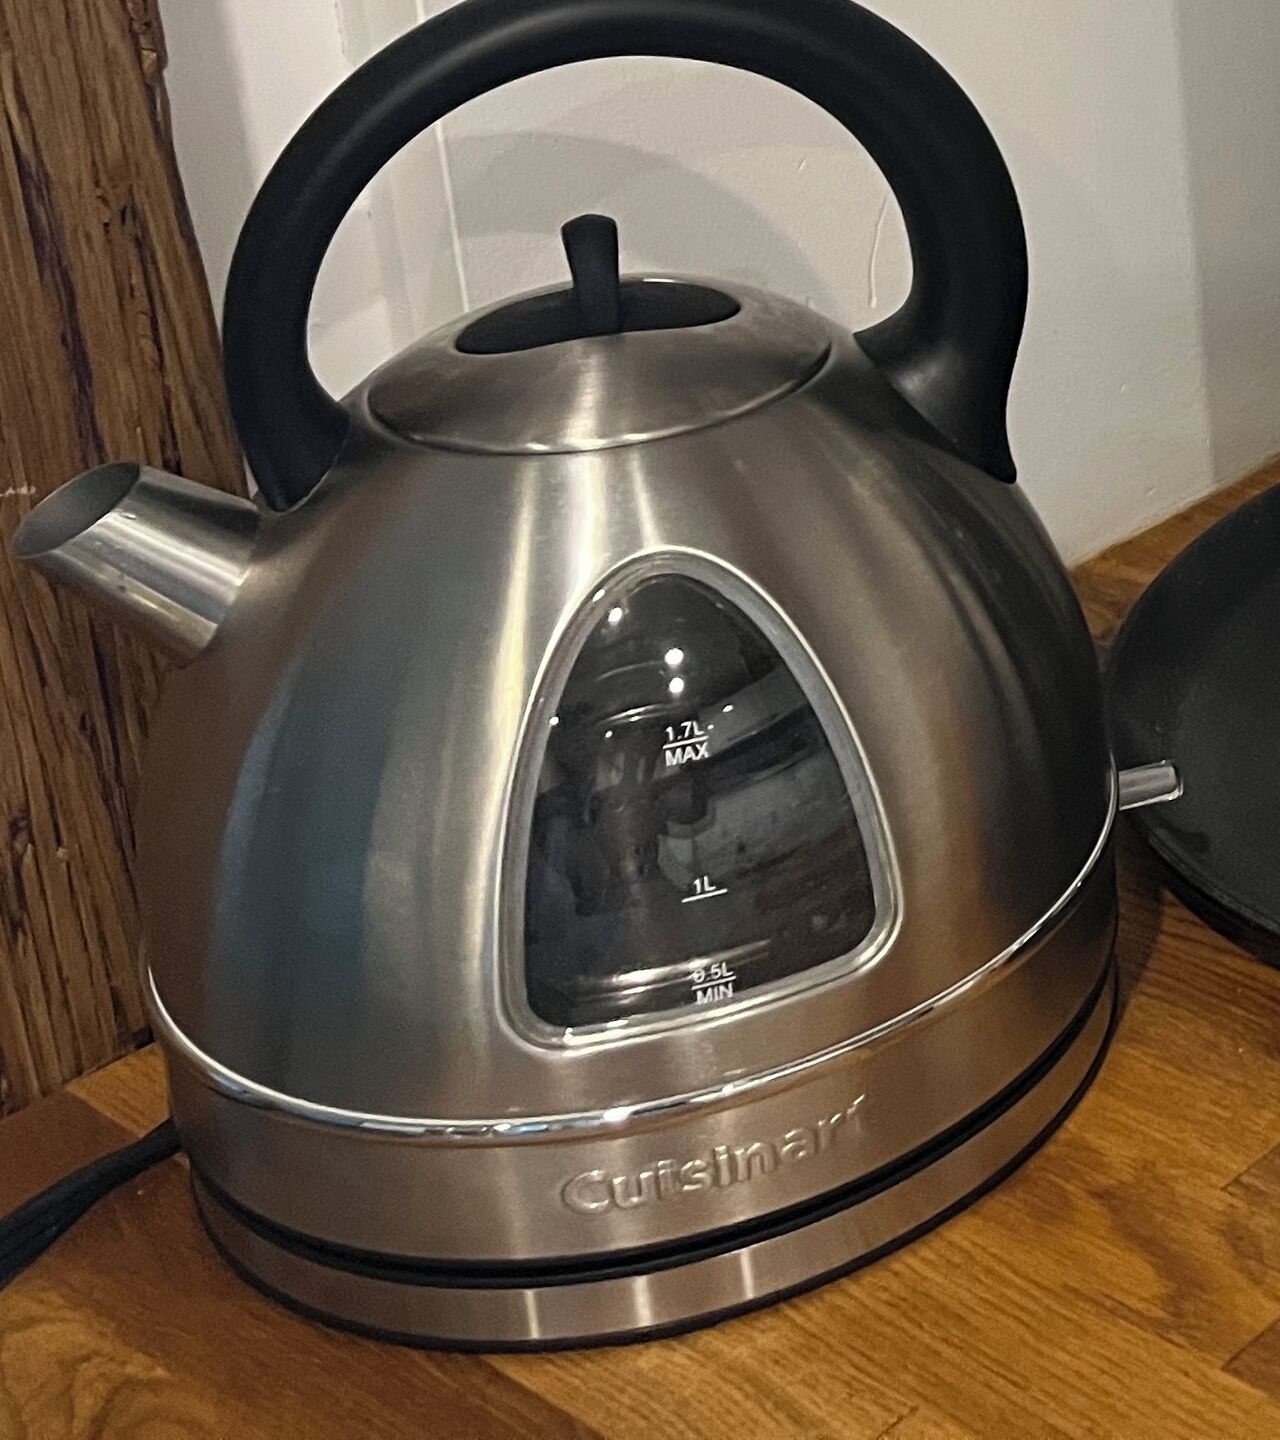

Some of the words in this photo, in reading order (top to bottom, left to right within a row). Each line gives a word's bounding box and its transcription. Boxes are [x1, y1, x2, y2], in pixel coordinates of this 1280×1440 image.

[666, 721, 705, 741] 1.7L
[665, 742, 709, 766] MAX
[693, 875, 717, 895] 1L
[693, 962, 734, 983] 0.5L
[696, 982, 733, 1004] MIN
[561, 1094, 865, 1214] Cuisinart
